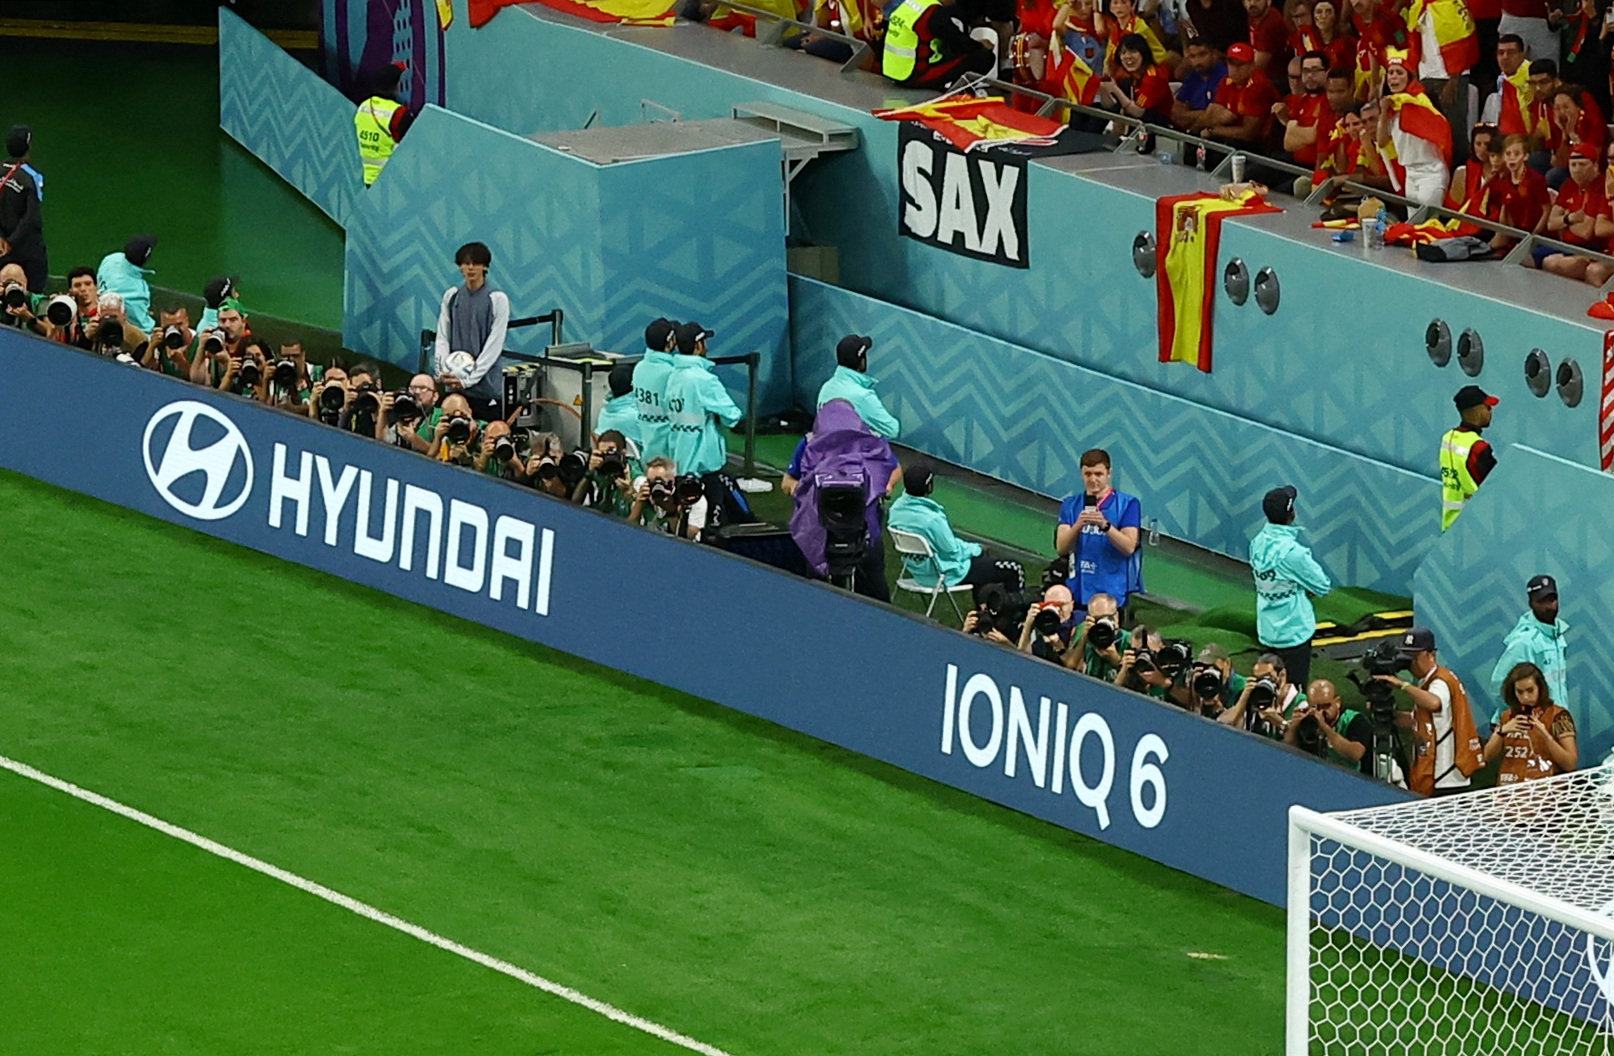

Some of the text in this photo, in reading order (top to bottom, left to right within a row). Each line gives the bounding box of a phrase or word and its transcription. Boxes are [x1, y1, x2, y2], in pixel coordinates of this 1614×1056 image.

[902, 140, 1020, 261] SAX
[268, 442, 554, 616] HYUNDAI
[941, 664, 1169, 831] IONIQ 6
[1505, 746, 1528, 758] 252
